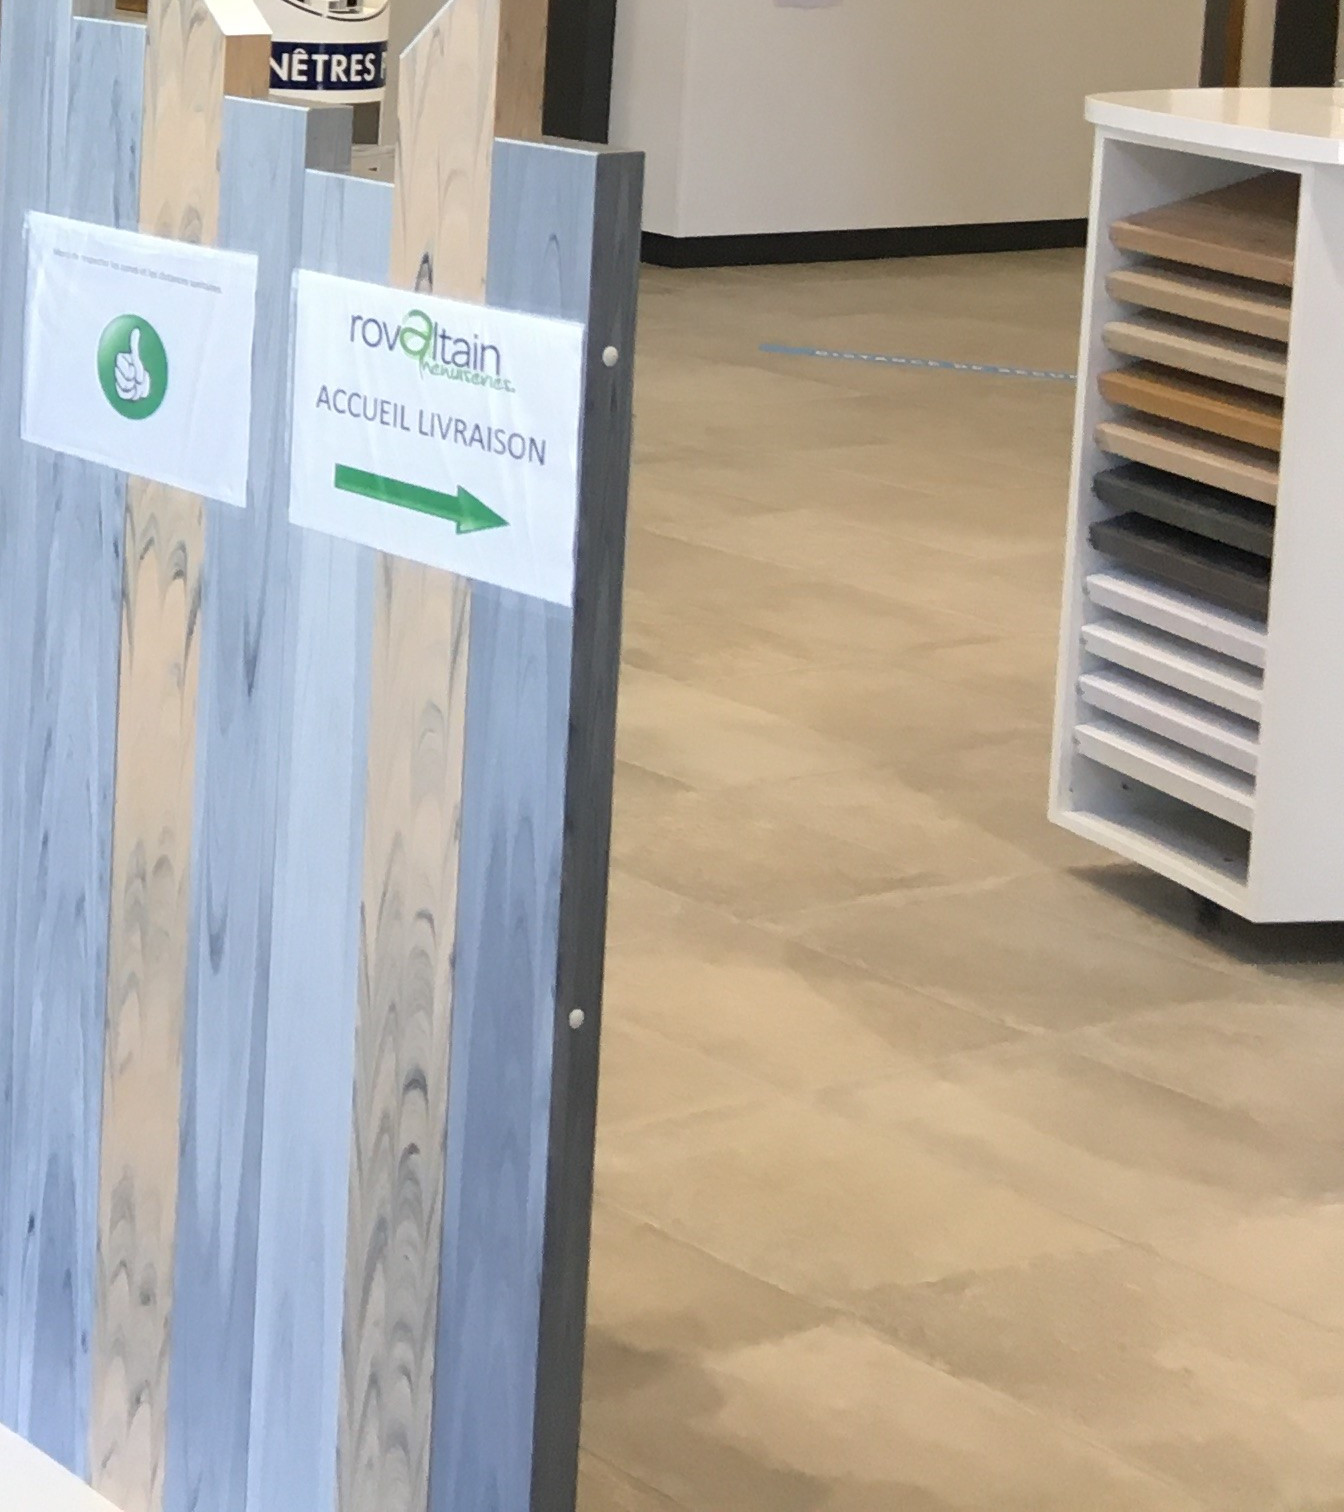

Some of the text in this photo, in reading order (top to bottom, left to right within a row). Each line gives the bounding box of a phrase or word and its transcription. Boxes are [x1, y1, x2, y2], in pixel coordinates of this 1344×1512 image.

[350, 309, 500, 375] rovaltain
[316, 385, 546, 466] ACCUEIL LIVRAISON
